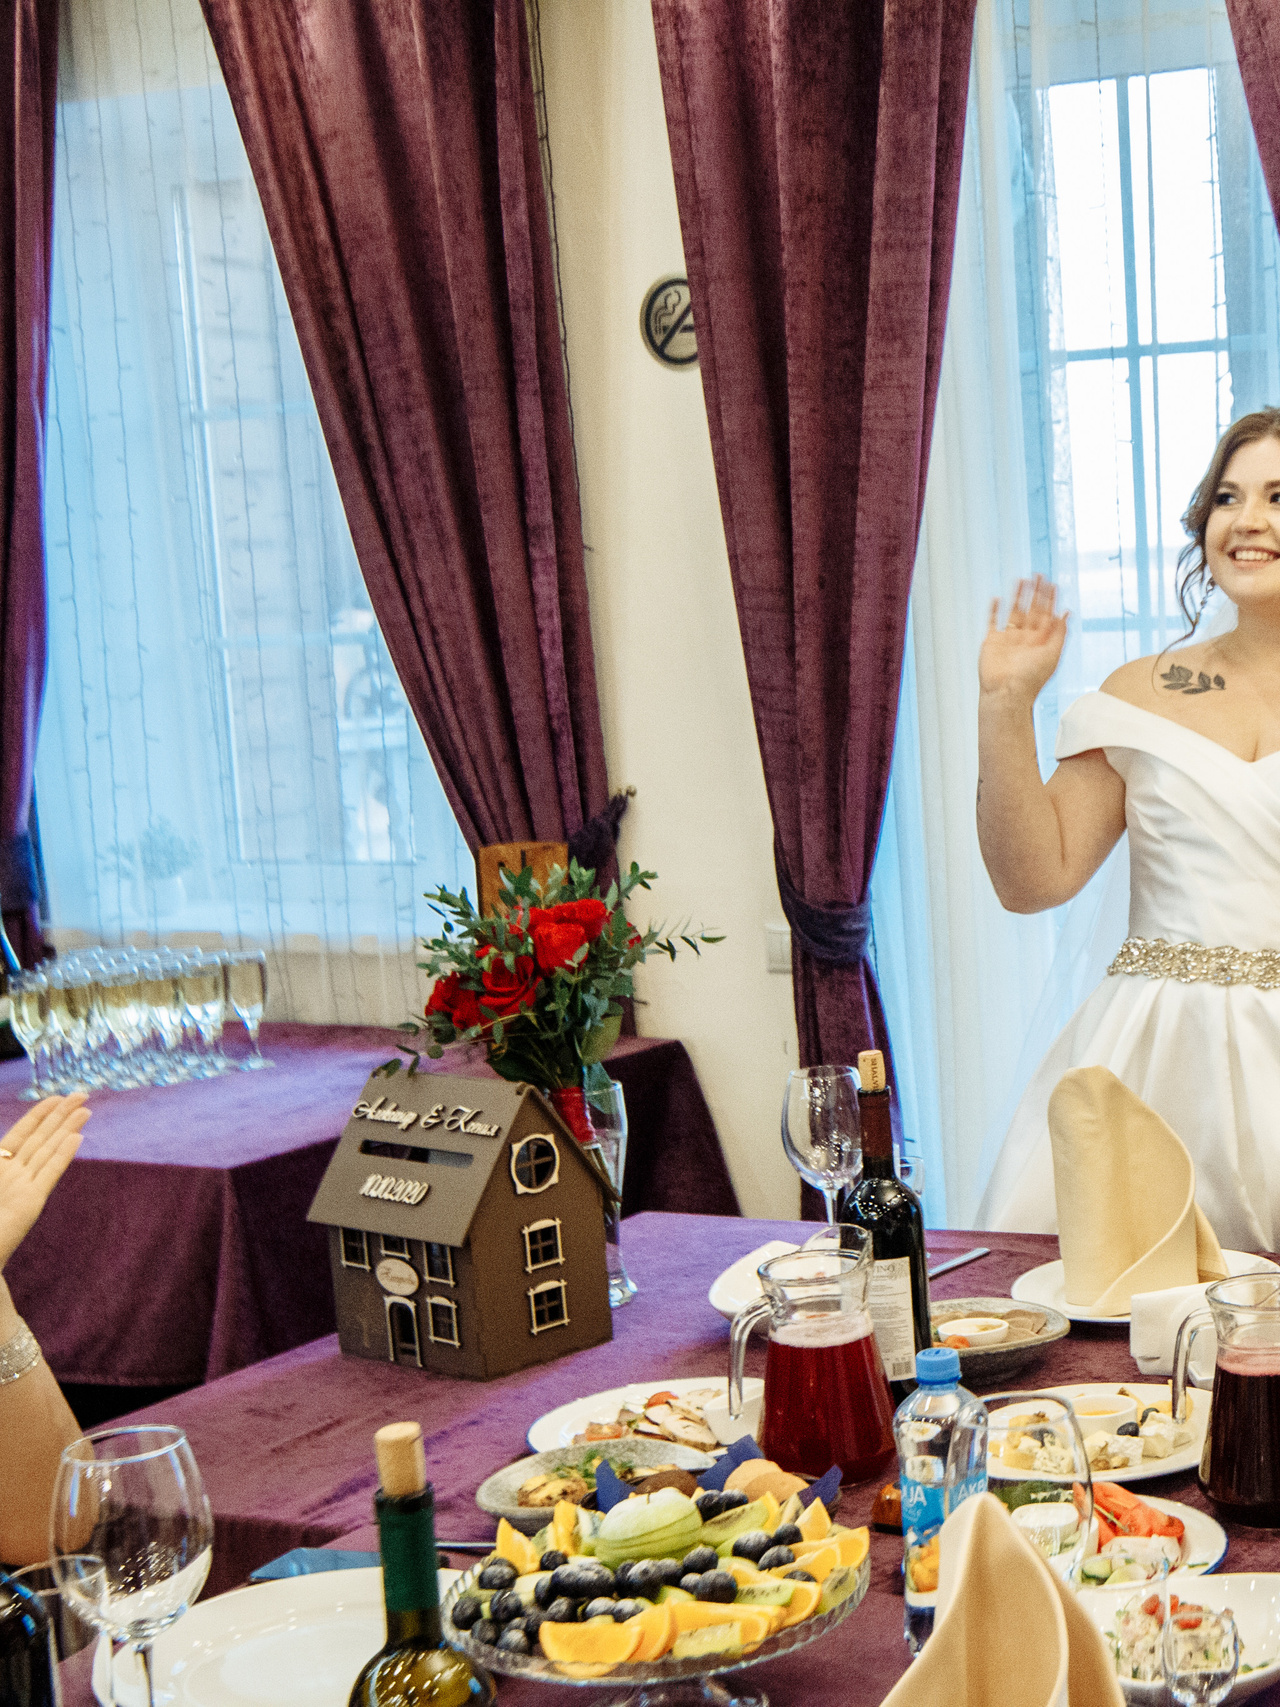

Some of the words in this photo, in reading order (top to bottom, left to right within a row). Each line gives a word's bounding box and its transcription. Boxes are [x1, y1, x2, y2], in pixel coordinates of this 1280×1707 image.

[870, 1057, 880, 1090] SHALVI
[420, 1103, 444, 1128] &
[901, 1484, 928, 1508] UA
